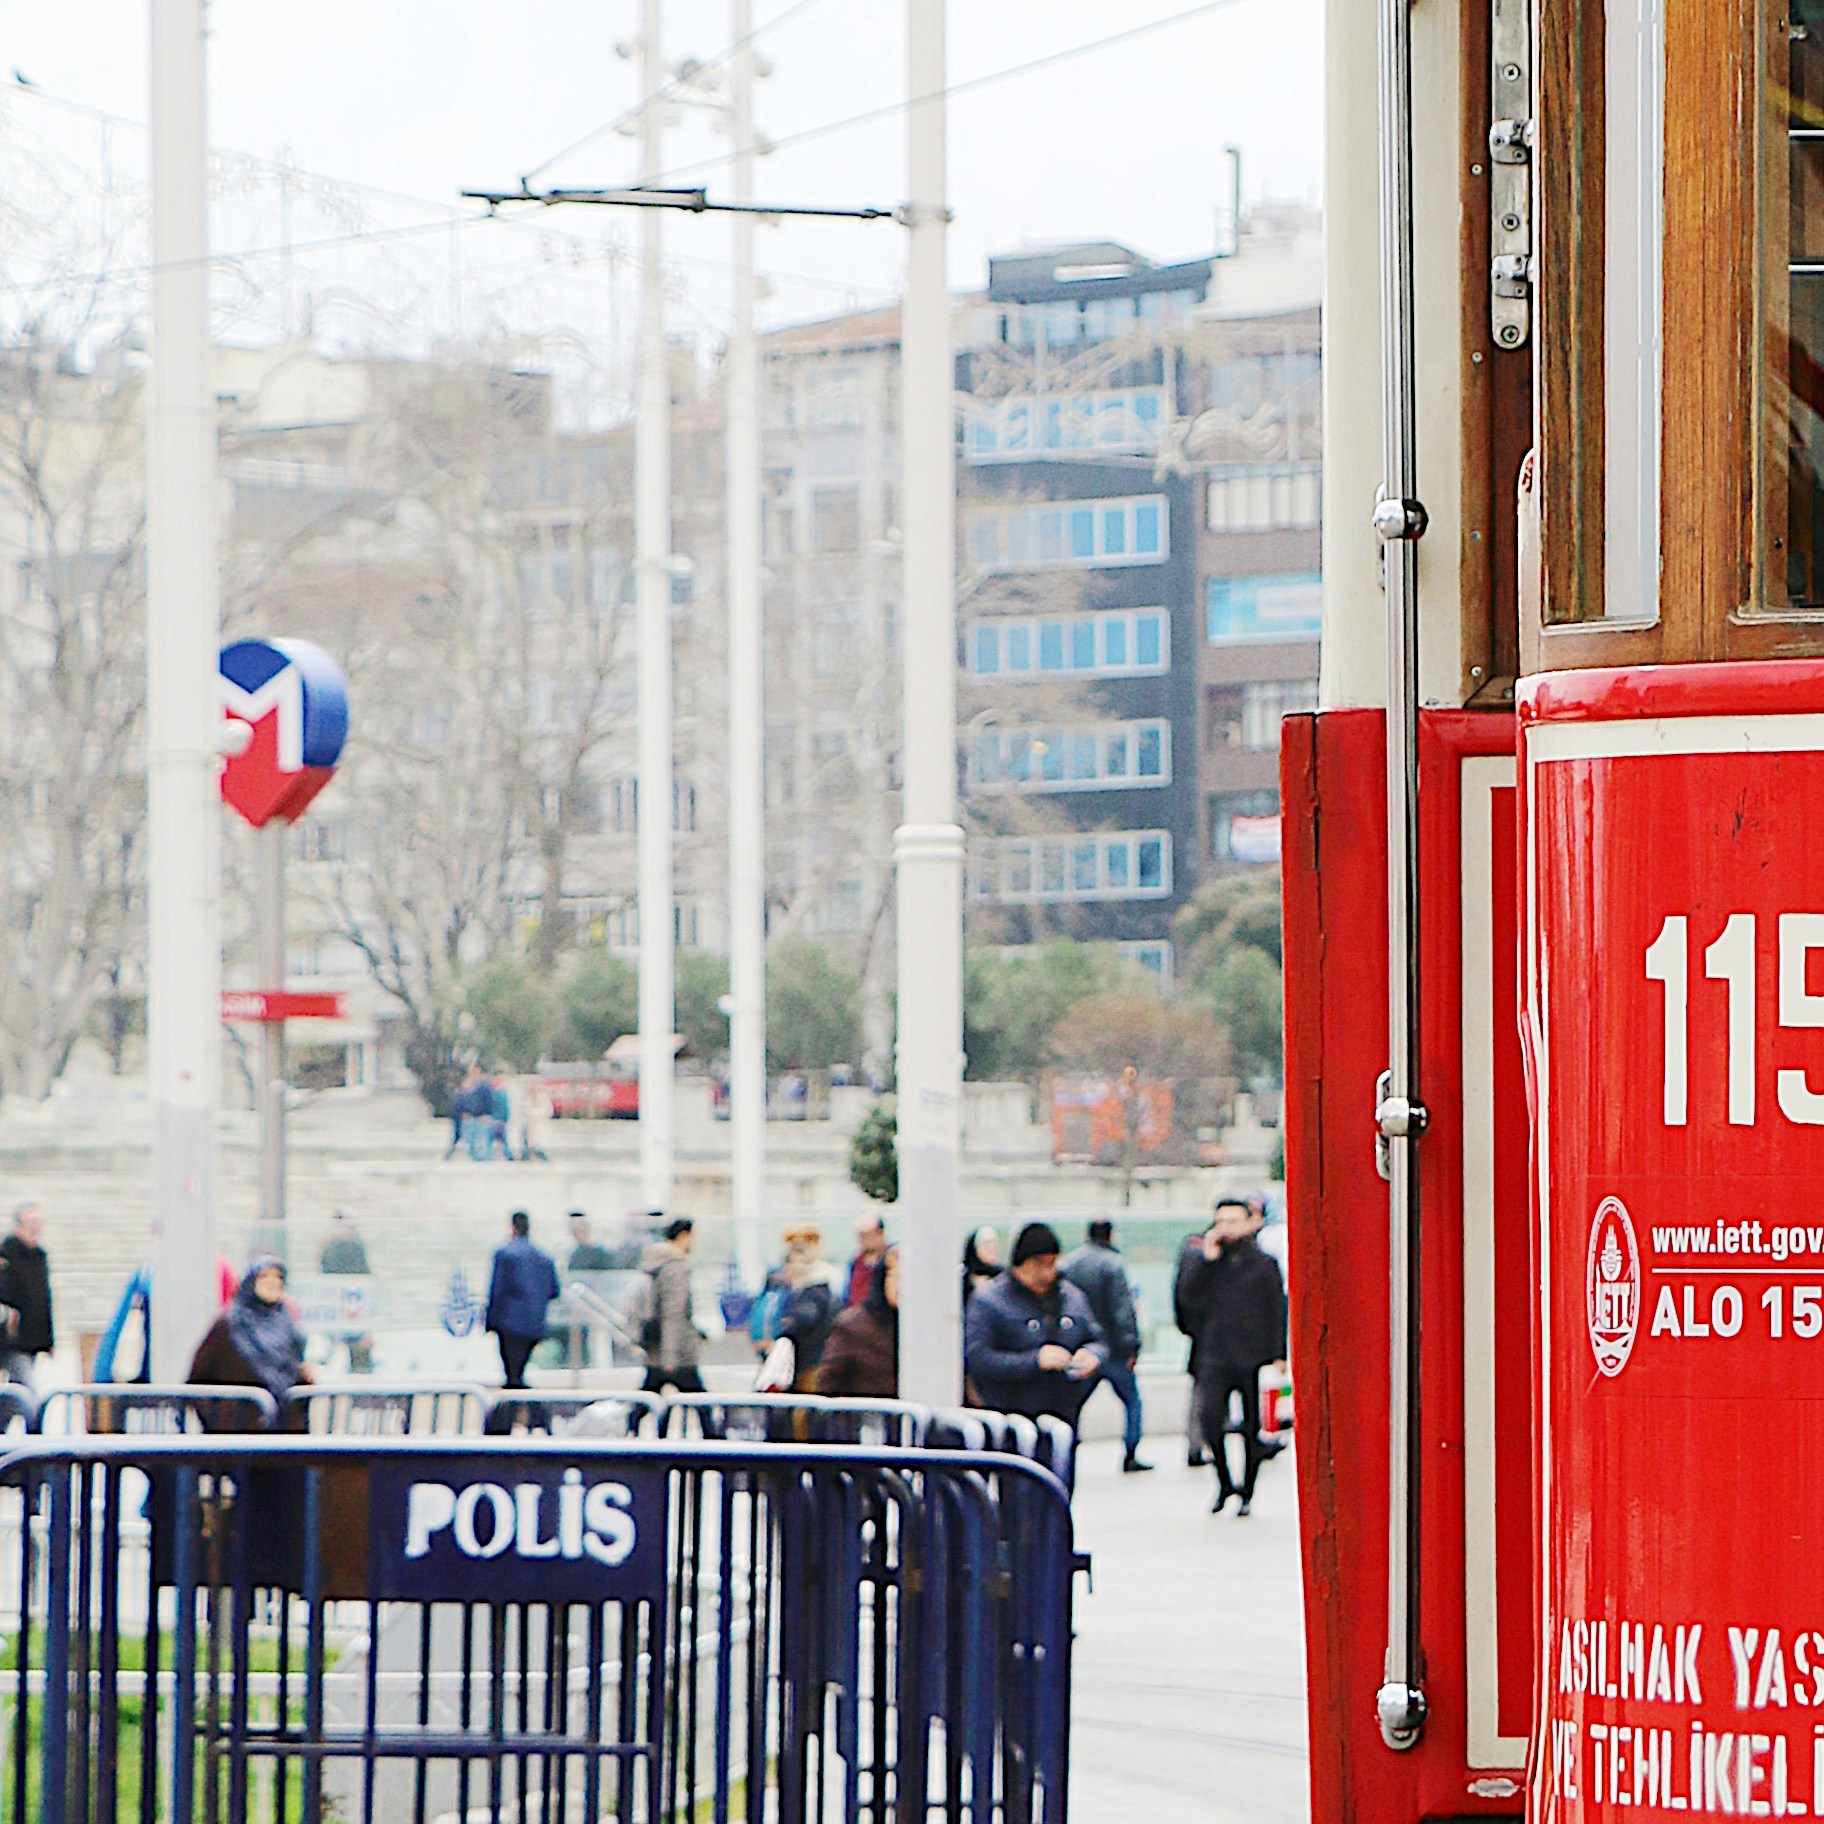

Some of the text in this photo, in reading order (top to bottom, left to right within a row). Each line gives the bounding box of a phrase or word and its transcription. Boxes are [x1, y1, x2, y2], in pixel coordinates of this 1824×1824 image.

[1650, 1285, 1743, 1338] ALO
[403, 1466, 637, 1568] POLİS
[1559, 1617, 1703, 1705] ASILMAK
[1552, 1717, 1578, 1801] VE
